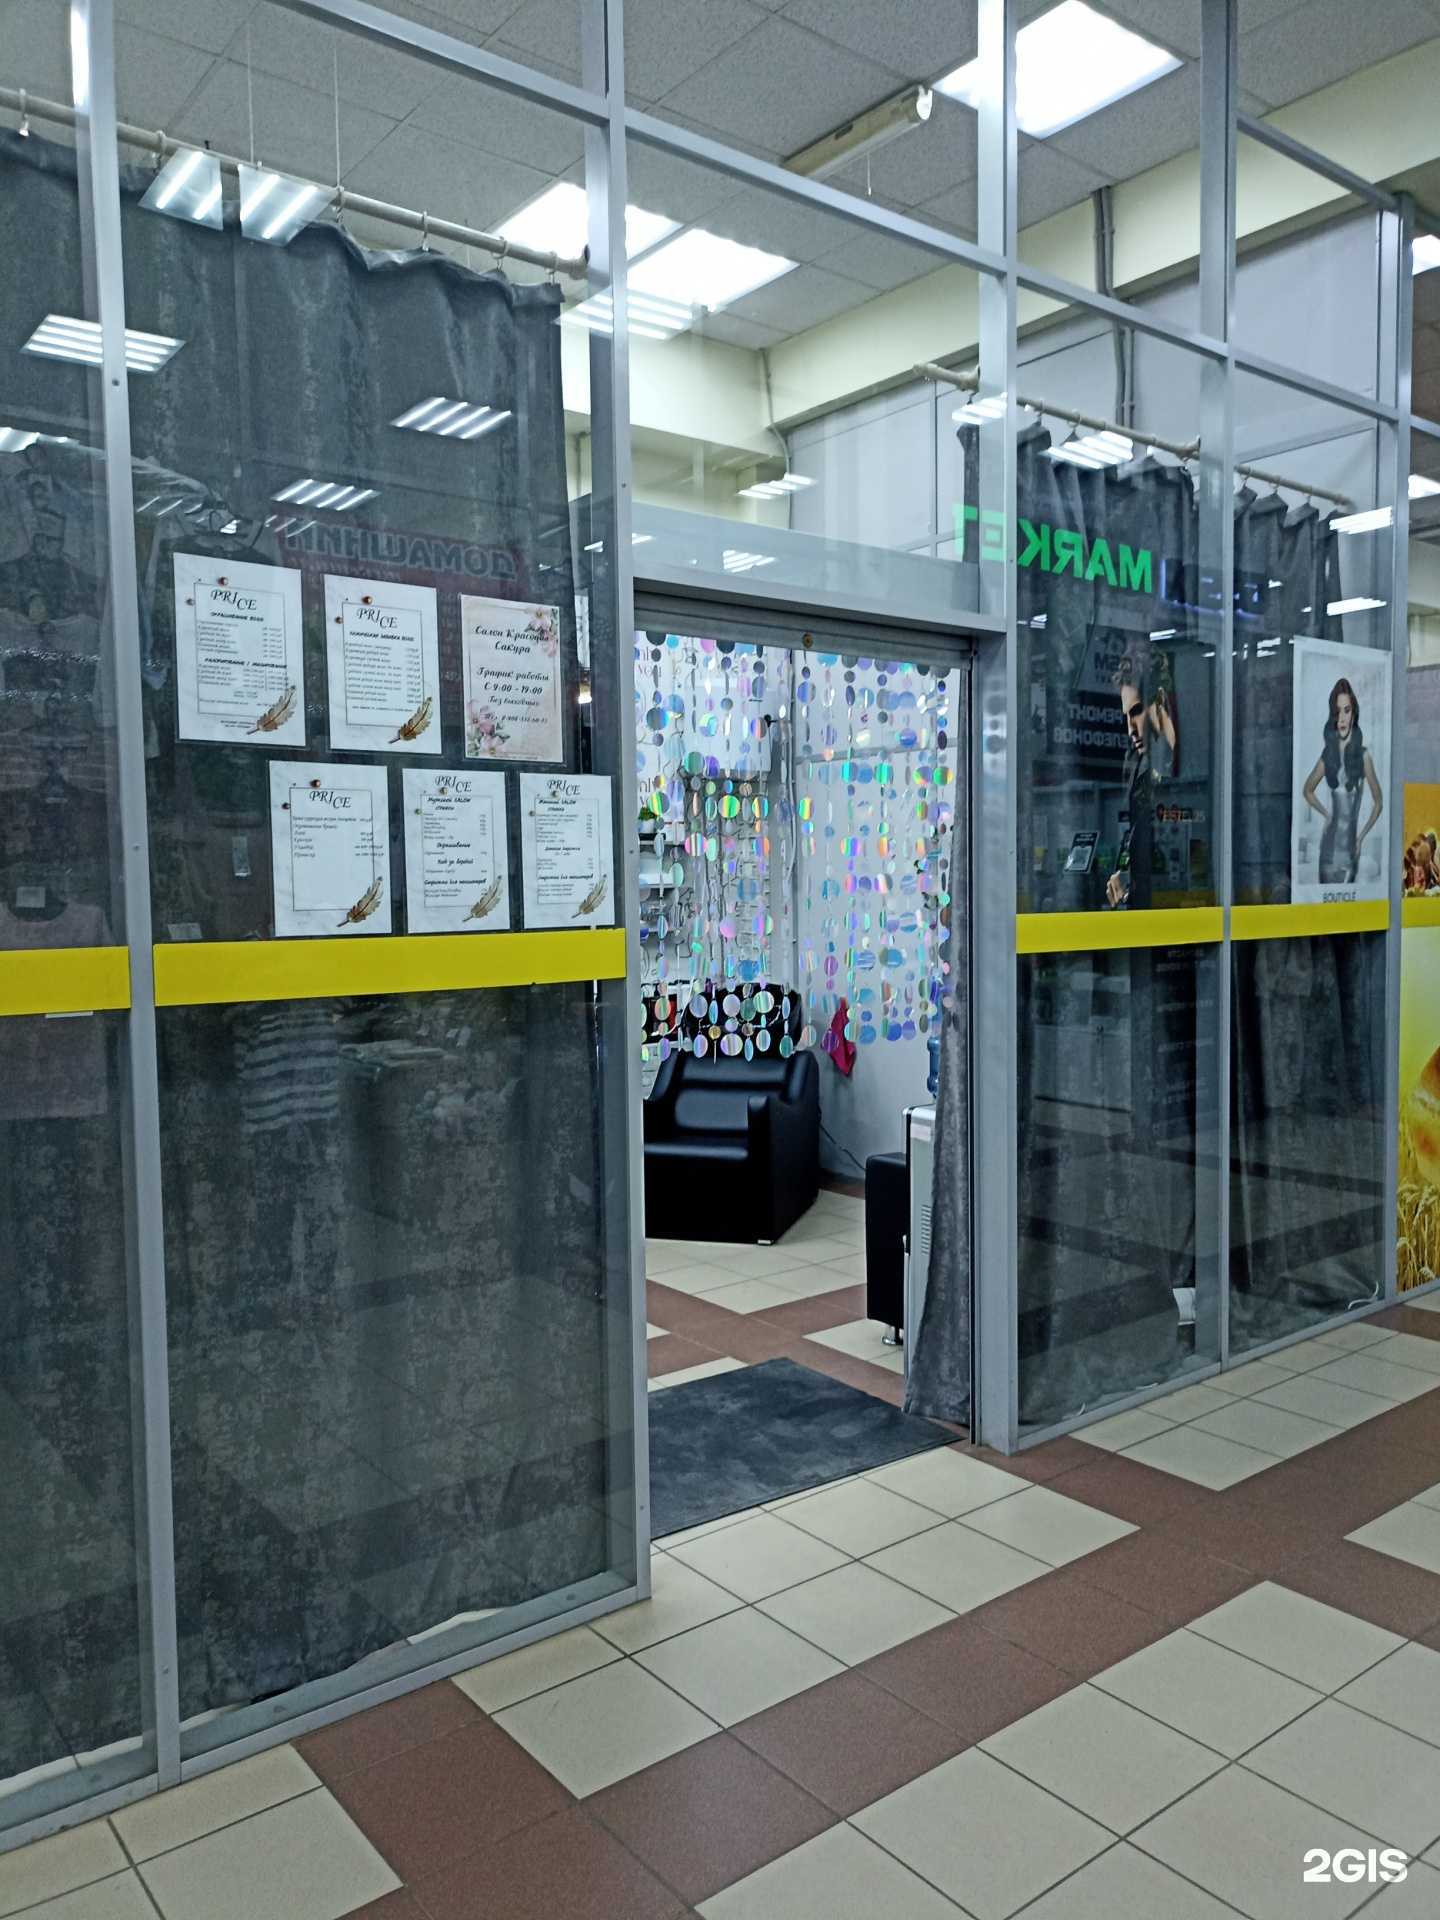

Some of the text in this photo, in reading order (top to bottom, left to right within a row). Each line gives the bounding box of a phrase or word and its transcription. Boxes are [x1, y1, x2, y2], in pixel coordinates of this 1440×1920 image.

[210, 588, 257, 611] PRICE
[356, 607, 398, 629] PRICE
[495, 640, 531, 655] Сакура
[435, 775, 473, 793] PRICE
[546, 779, 581, 796] PRICE
[309, 790, 352, 809] PRICE
